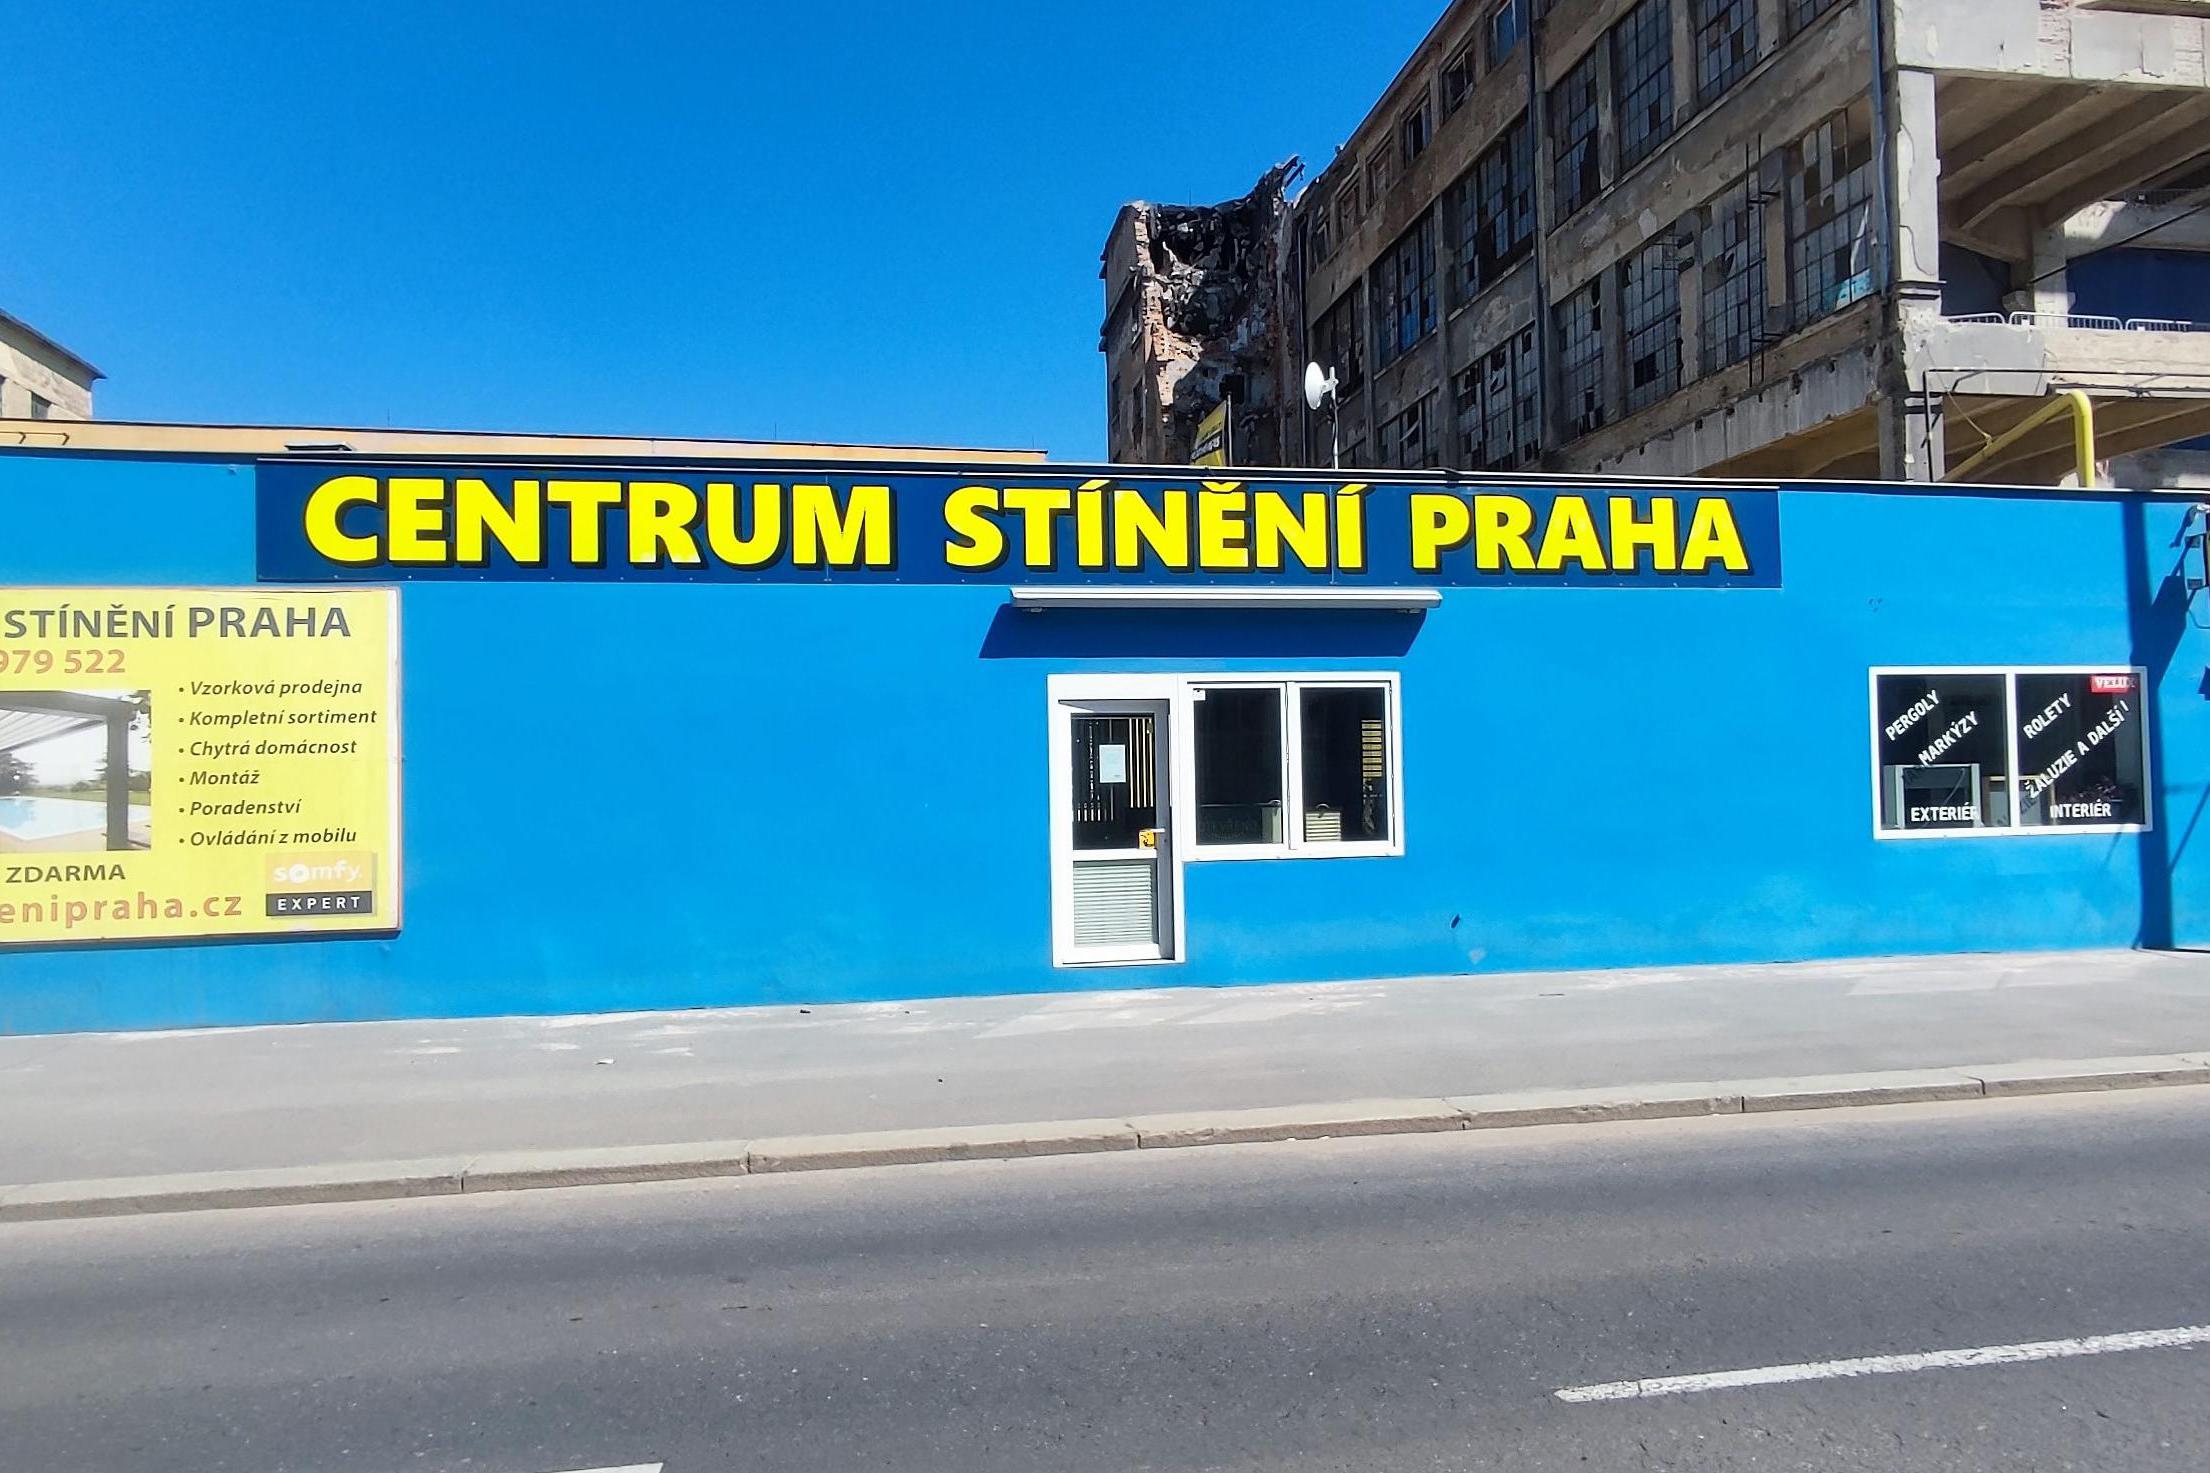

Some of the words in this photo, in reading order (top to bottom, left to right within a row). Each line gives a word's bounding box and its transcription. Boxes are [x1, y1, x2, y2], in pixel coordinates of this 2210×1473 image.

[304, 475, 893, 567] CENTRUM
[943, 480, 1369, 569] STÍNĚNÍ
[1410, 494, 1749, 570] PRAHA
[4, 603, 176, 638] STÍNĚNÍ
[188, 606, 351, 638] PRAHA
[64, 649, 126, 674] 522
[190, 680, 275, 695] Vzorková
[279, 680, 362, 698] prodejna
[189, 710, 285, 728] Kompletní
[288, 710, 377, 724] sortiment
[1885, 689, 1939, 741] PERGOLY
[2023, 693, 2071, 739] ROLETY
[190, 740, 250, 759] Chytrá
[255, 739, 357, 755] domácnost
[1918, 710, 1978, 767] MARKÝZY
[189, 769, 260, 785] Montáž
[2024, 749, 2078, 799] ŽALUZIE
[2077, 741, 2090, 756] A
[190, 799, 302, 815] Poradenství
[1910, 801, 1980, 822] EXTERIÉR
[2050, 798, 2112, 818] INTERIÉR
[190, 829, 276, 846] Ovládání
[279, 832, 289, 844] z
[293, 827, 357, 844] mobilu
[6, 864, 126, 883] ZDARMA
[273, 859, 360, 883] somfy
[0, 891, 242, 928] enipraha.cz
[277, 896, 360, 911] EXPERT
